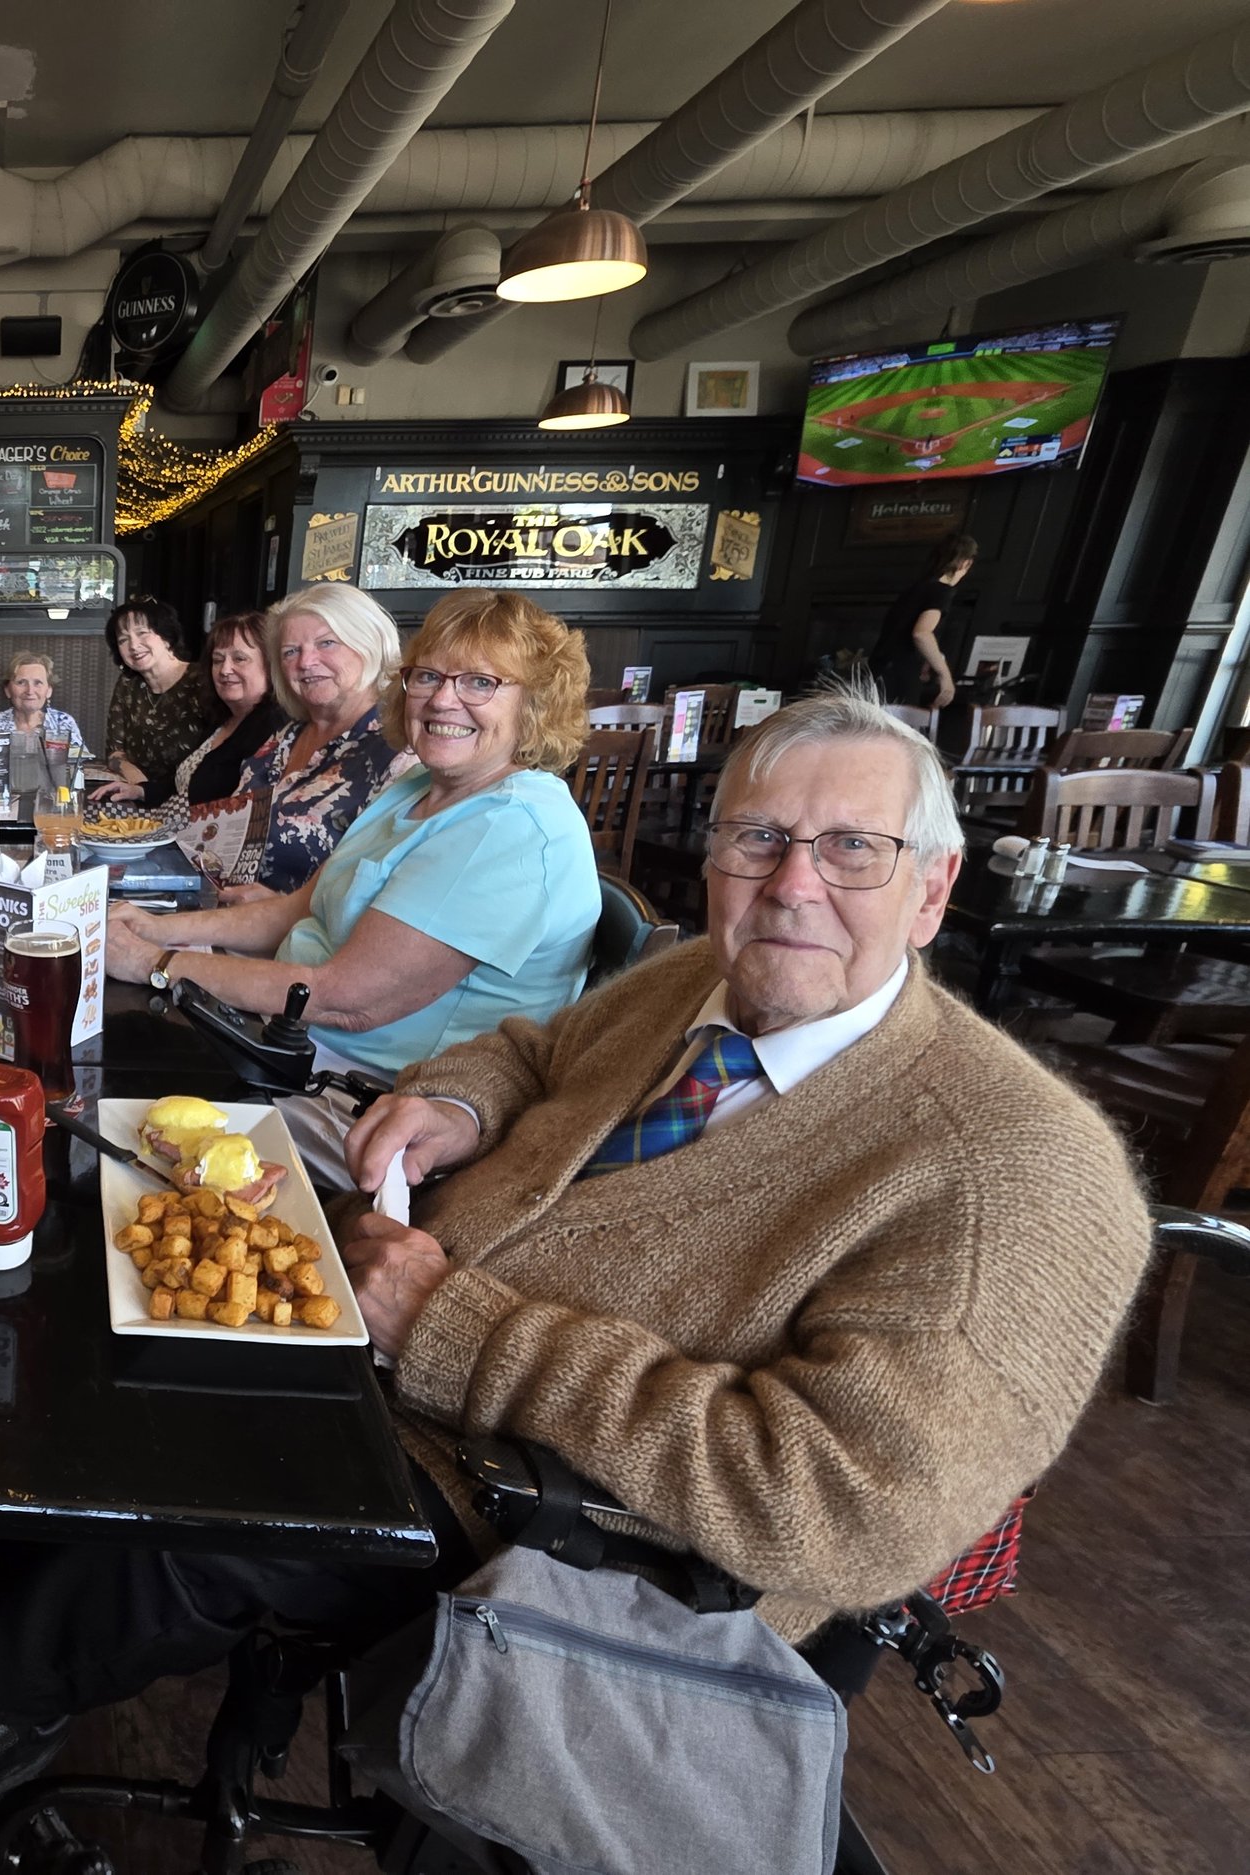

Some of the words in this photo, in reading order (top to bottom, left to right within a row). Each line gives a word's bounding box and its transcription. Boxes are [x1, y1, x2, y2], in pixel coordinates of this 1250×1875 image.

[118, 295, 175, 319] GUINNESS
[51, 445, 89, 461] Choice
[380, 473, 472, 493] ARTHUR
[472, 471, 599, 493] GUINNESS
[599, 470, 629, 492] &
[632, 471, 699, 492] SONS
[513, 514, 559, 527] THE
[424, 524, 548, 565] ROYAL
[552, 525, 648, 557] OAK
[465, 568, 507, 578] FINE
[509, 567, 547, 579] PUB
[240, 849, 262, 860] PUBS
[233, 861, 258, 875] OAK
[46, 884, 101, 921] Sweeter
[79, 900, 100, 917] SIDE
